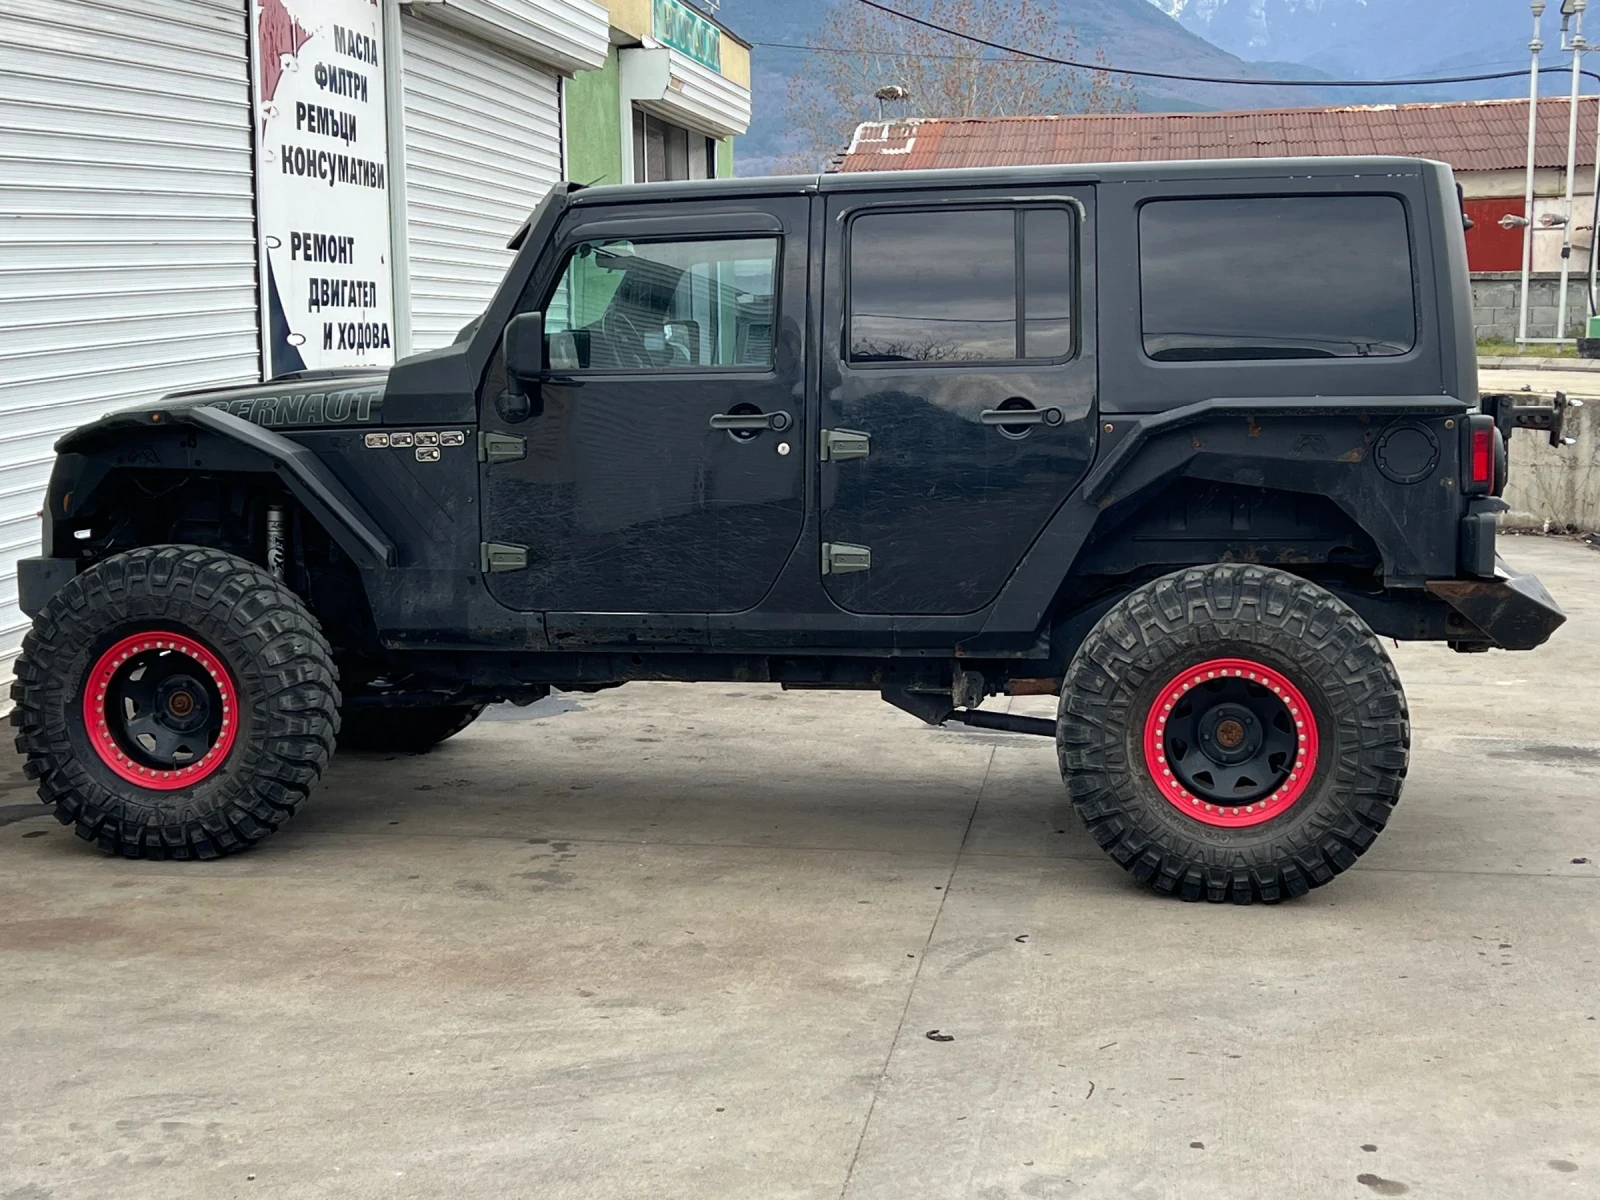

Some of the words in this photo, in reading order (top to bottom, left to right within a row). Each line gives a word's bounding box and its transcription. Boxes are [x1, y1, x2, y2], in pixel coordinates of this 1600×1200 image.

[333, 24, 378, 67] МАСЛА
[314, 61, 368, 103] ФИЛТРИ
[296, 101, 357, 147] РЕМЪЦИ
[281, 144, 385, 190] КОНСУМАТИВИ
[290, 231, 354, 264] РЕМОНТ
[308, 277, 377, 313] ДВИГАТЕЛ
[323, 322, 333, 350] И
[337, 322, 391, 356] ХОДОВА
